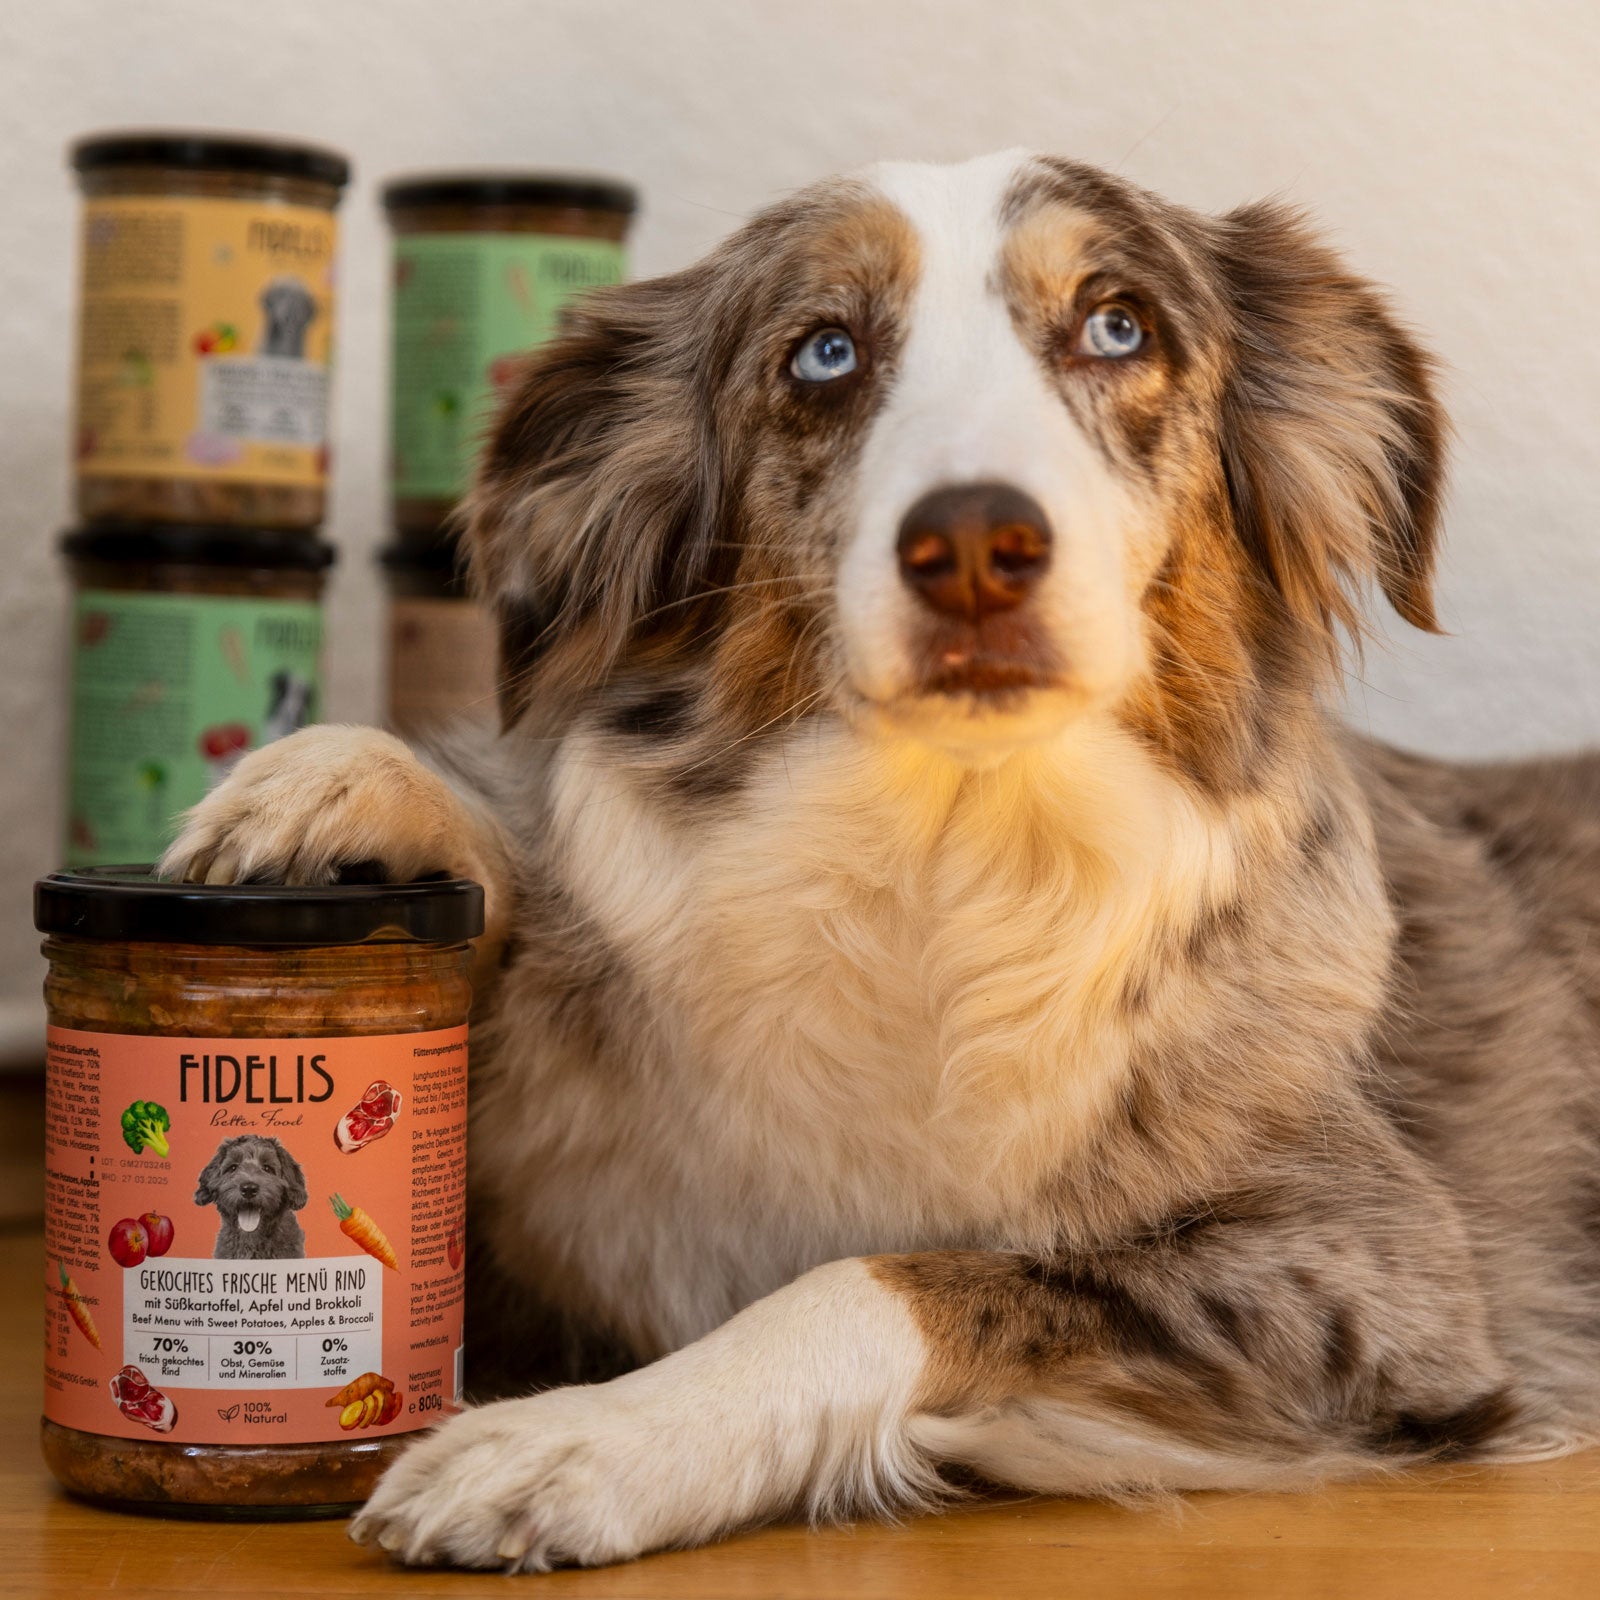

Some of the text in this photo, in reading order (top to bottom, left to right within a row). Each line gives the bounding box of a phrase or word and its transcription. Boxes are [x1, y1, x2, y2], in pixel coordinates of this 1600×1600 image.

[88, 1072, 100, 1080] und
[180, 1054, 334, 1103] FIDELIS
[412, 1069, 439, 1081] Junghund
[412, 1084, 431, 1093] Young
[432, 1082, 442, 1091] dog
[412, 1094, 429, 1104] Hund
[441, 1091, 450, 1100] Dog
[412, 1106, 428, 1116] Hund
[429, 1105, 436, 1113] ab
[440, 1103, 449, 1112] Dog
[210, 1108, 303, 1127] Better Food
[412, 1130, 423, 1140] Die
[412, 1141, 434, 1153] gewicht
[412, 1154, 430, 1163] einem
[412, 1177, 427, 1187] 400g
[428, 1175, 443, 1184] Futter
[86, 1189, 100, 1199] Beef
[411, 1187, 441, 1198] Richtwerte
[411, 1201, 430, 1210] aktive,
[90, 1213, 100, 1222] 7%
[411, 1224, 428, 1233] Rasse
[430, 1222, 441, 1231] oder
[140, 1268, 366, 1294] GEKOCHTES FRISCHE MENÜ RIND
[411, 1282, 422, 1291] The
[145, 1295, 362, 1315] mit Süßkartoffel, Apfel und Brokkoli
[410, 1295, 423, 1305] your
[410, 1306, 425, 1315] from
[426, 1304, 434, 1312] the
[132, 1312, 374, 1329] Beef Menu with Sweet Potatoes, Apples & Broccoli
[410, 1316, 431, 1327] activity
[153, 1337, 189, 1353] 70%
[233, 1341, 272, 1355] 30%
[322, 1338, 348, 1352] 0%
[139, 1353, 204, 1367] frisch gekochtes
[220, 1358, 285, 1368] Obst, Gemüse
[320, 1356, 350, 1365] Zusatz-
[161, 1366, 180, 1376] Rind
[219, 1369, 286, 1379] und Mineralien
[323, 1366, 347, 1377] stoffe
[408, 1379, 442, 1392] Net Quantity
[243, 1402, 272, 1412] 100%
[419, 1393, 442, 1412] 800g
[243, 1413, 287, 1423] Natural
